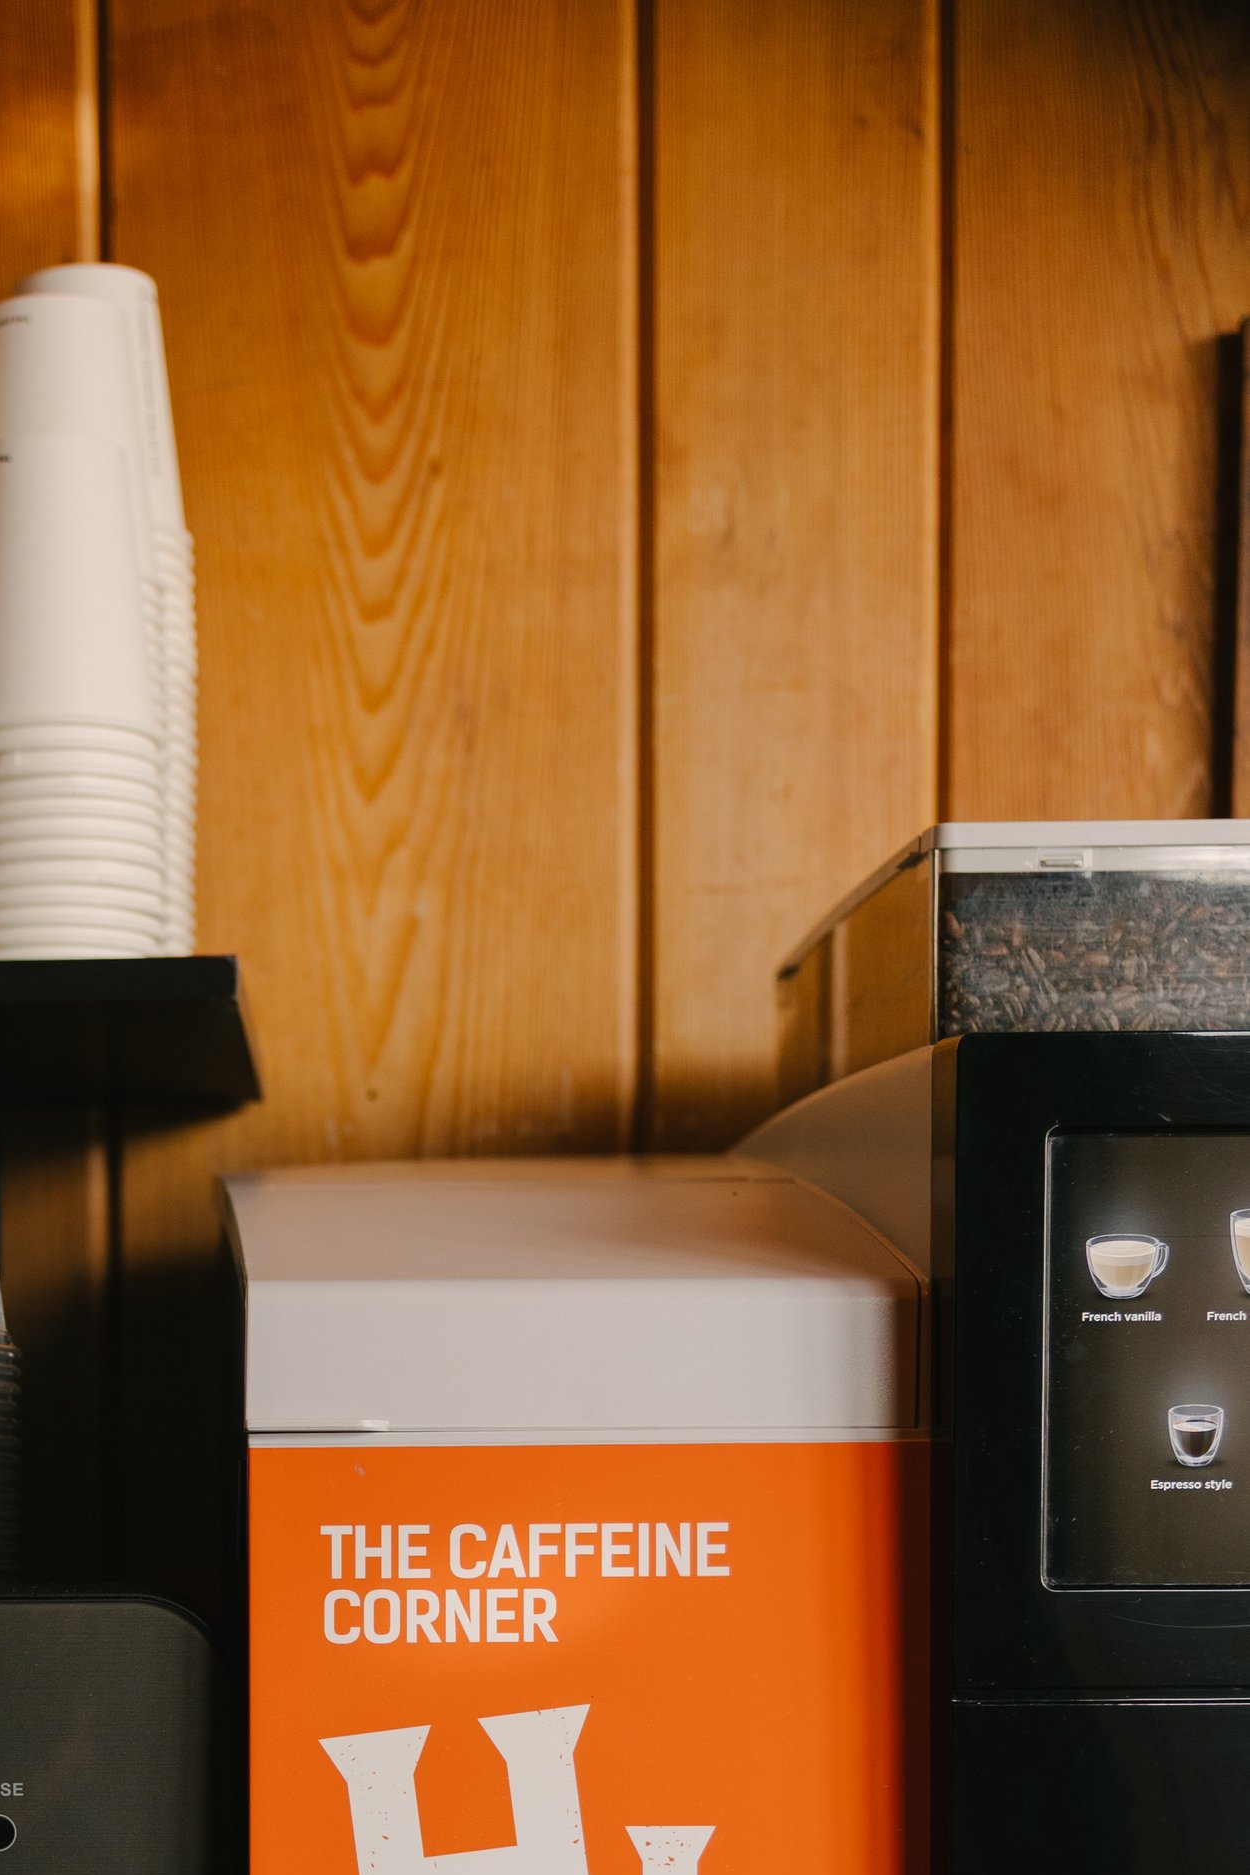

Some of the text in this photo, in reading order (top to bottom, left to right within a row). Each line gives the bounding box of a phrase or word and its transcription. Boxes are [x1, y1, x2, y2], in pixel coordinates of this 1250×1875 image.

[1081, 1311, 1162, 1322] French vanilla
[1206, 1310, 1247, 1321] French
[1150, 1479, 1233, 1491] Espresso style
[320, 1521, 731, 1579] THE CAFFEINE
[323, 1588, 559, 1645] CORNER
